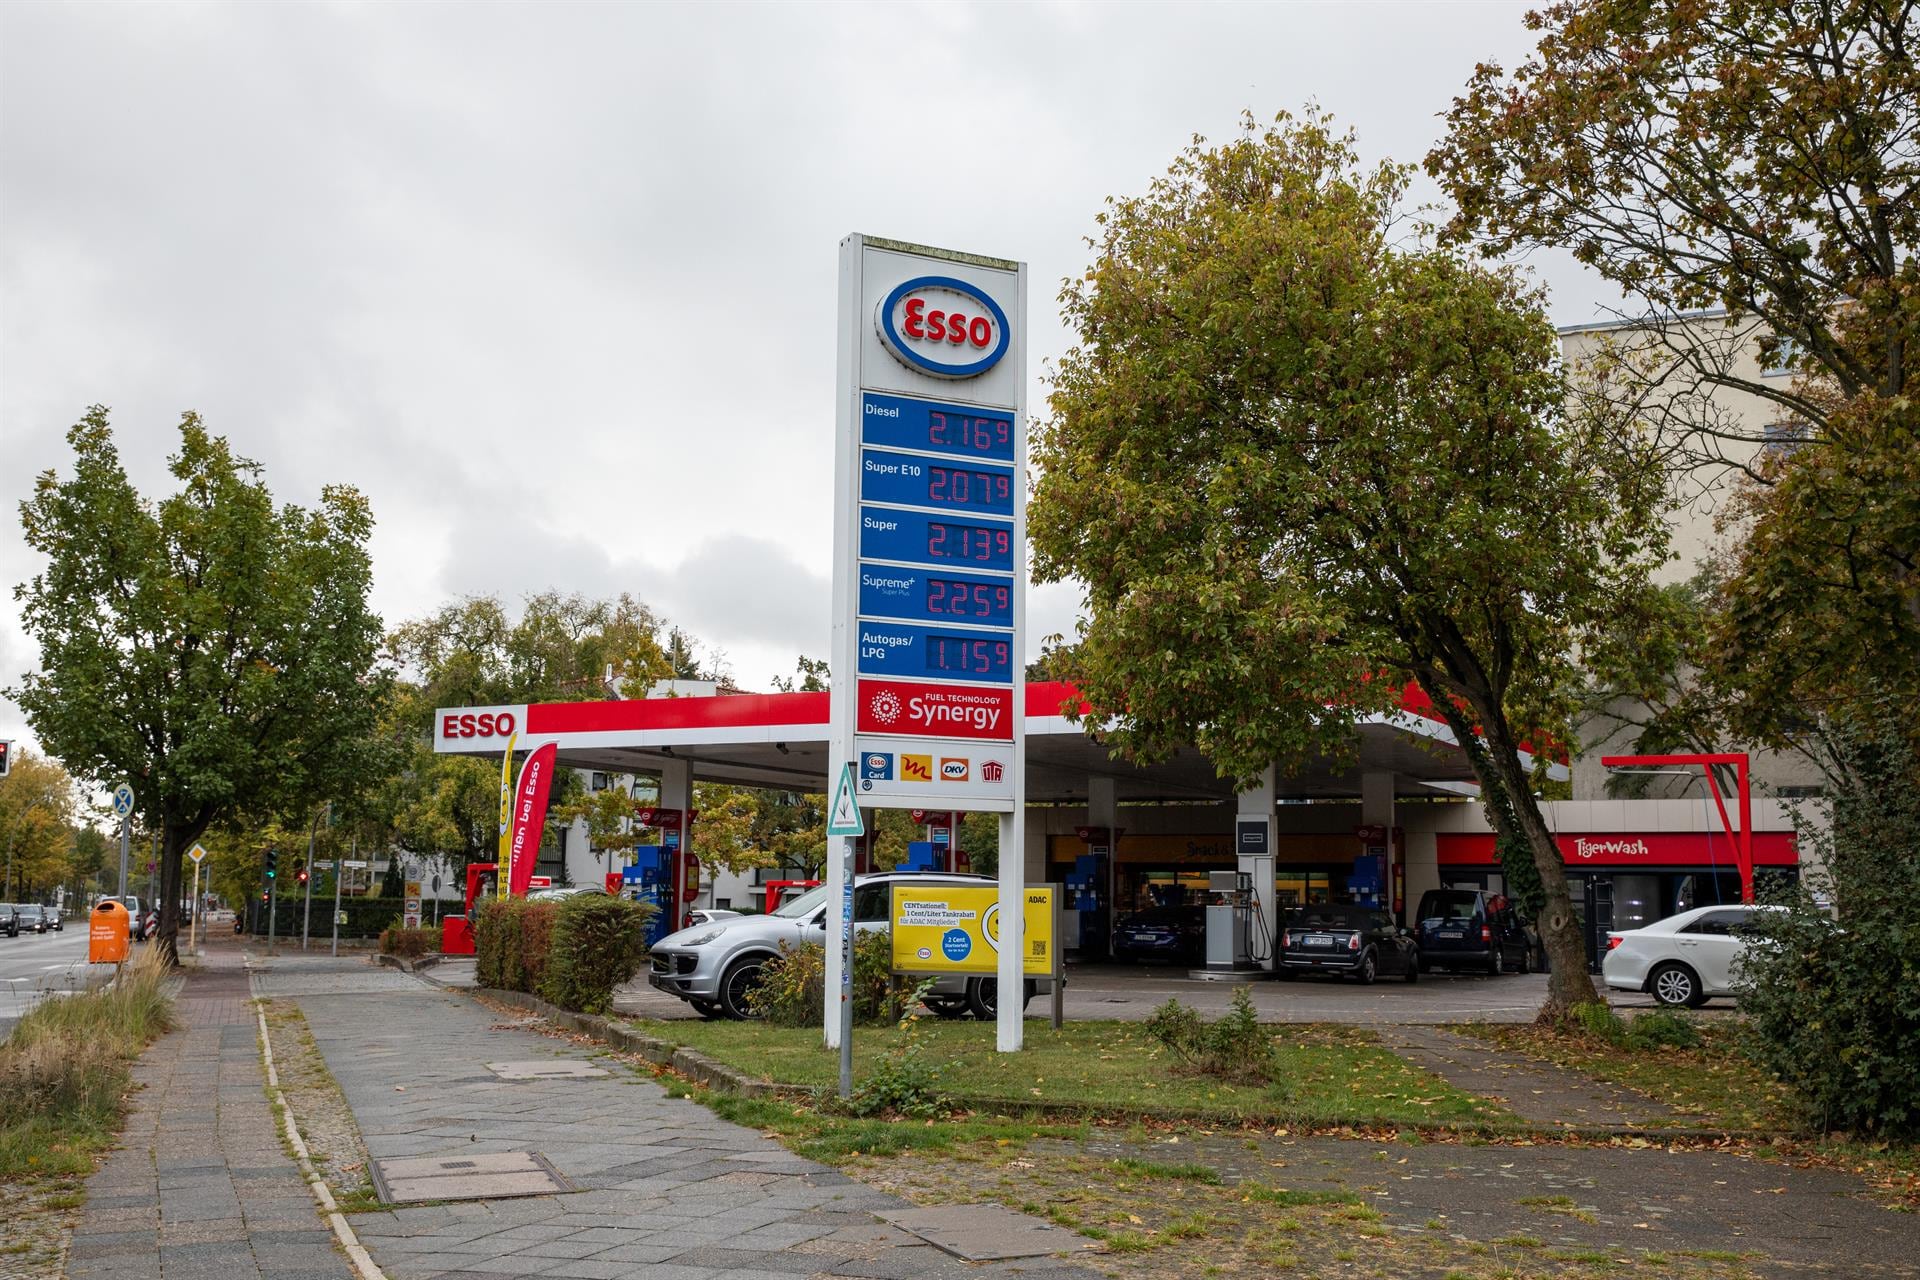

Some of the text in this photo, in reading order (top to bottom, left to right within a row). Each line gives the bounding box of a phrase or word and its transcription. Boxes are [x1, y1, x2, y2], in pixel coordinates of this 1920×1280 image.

[904, 298, 992, 350] Esso
[865, 403, 900, 419] Diesel
[929, 412, 1009, 450] 2.169
[864, 460, 921, 476] Super E10
[928, 468, 1009, 504] 2.079
[863, 517, 898, 532] Super
[929, 525, 1008, 560] 2.139
[882, 589, 910, 597] Super Plus
[928, 581, 1008, 617] 2.259
[861, 632, 913, 647] Autogas/
[861, 647, 886, 660] LPG
[938, 640, 1008, 673] 1.159
[925, 693, 1001, 705] FUEL TECHNOLOGY
[908, 697, 1001, 730] Synergy
[443, 713, 515, 738] ESSO
[869, 757, 886, 767] Esso
[943, 764, 966, 774] DKV
[526, 762, 540, 795] Esso
[868, 771, 885, 779] Card
[983, 762, 1002, 781] UTA
[520, 800, 533, 822] bei
[1186, 840, 1218, 857] Snack
[1574, 838, 1648, 859] TigerWash
[1028, 895, 1048, 904] ADAC
[909, 917, 926, 925] ADAC
